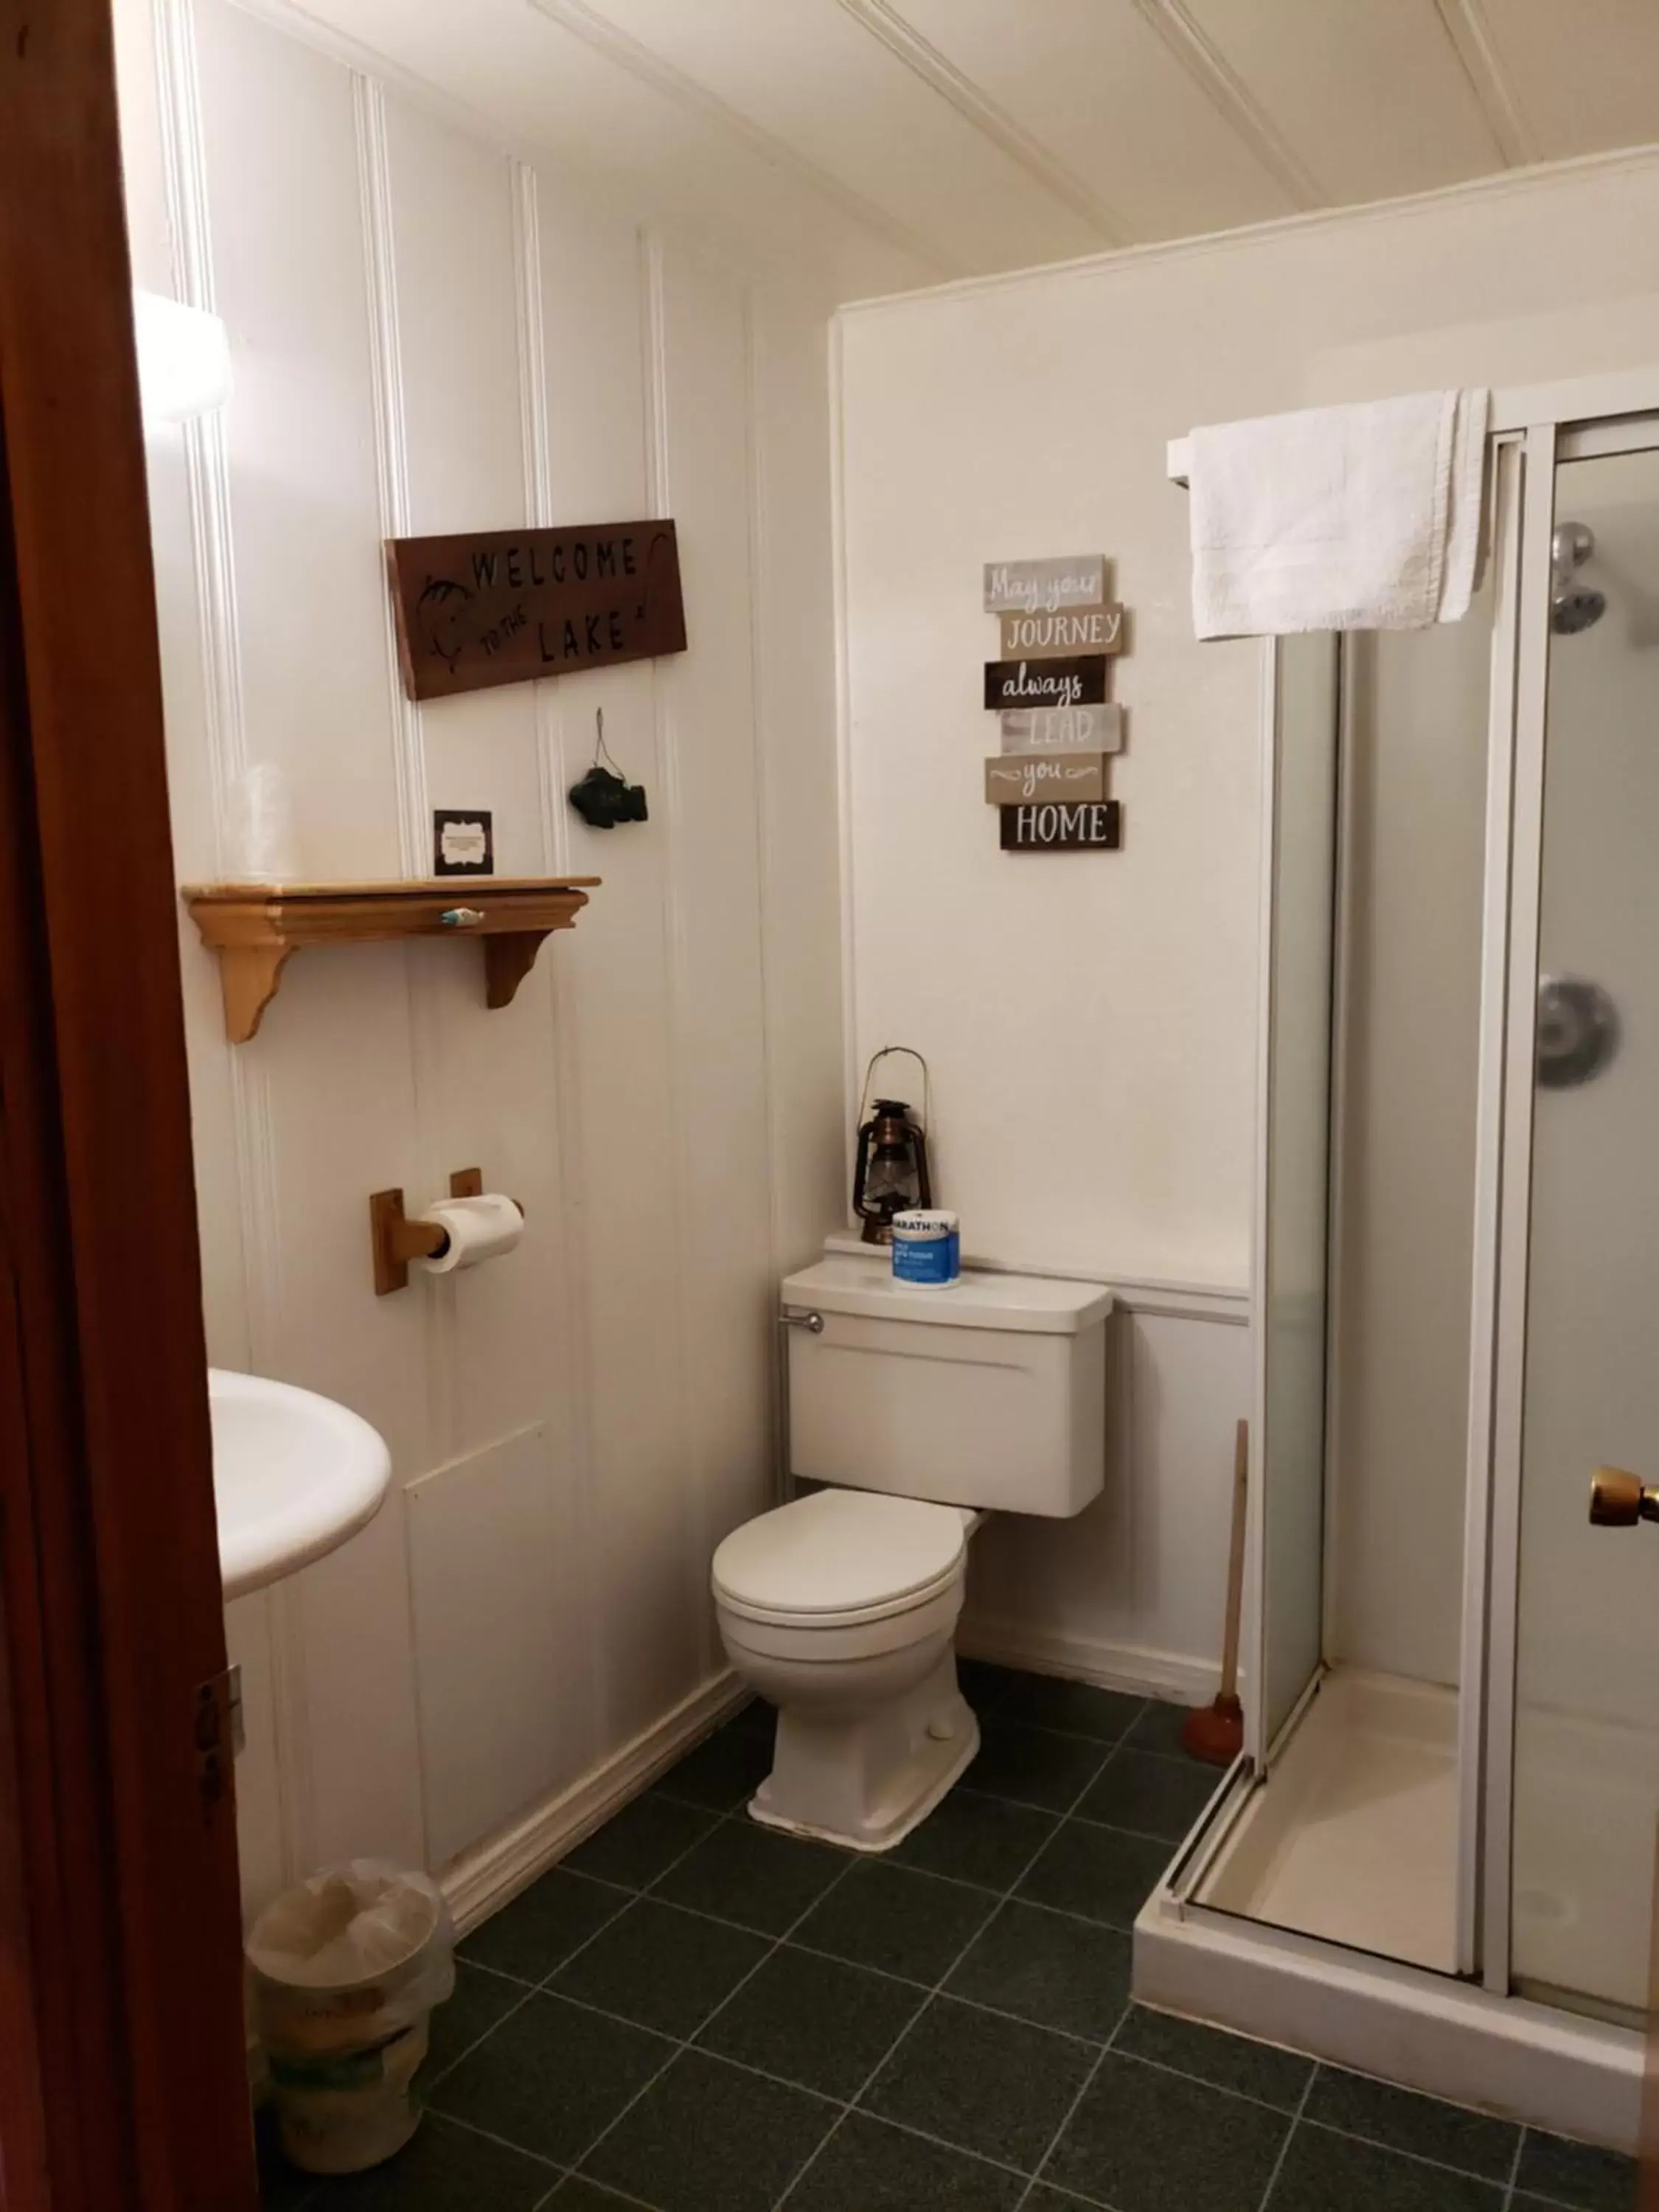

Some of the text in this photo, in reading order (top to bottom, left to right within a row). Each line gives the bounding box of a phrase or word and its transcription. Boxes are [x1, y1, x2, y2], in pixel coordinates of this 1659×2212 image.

[472, 538, 636, 589] WELCOME
[990, 566, 1097, 613] May your
[479, 603, 527, 656] TO THE
[538, 611, 625, 663] LAKE
[1007, 613, 1121, 649] JOURNEY
[1002, 661, 1083, 708] always
[1029, 710, 1094, 745] LEAD
[1022, 762, 1062, 797] you
[1017, 804, 1108, 843] HOME
